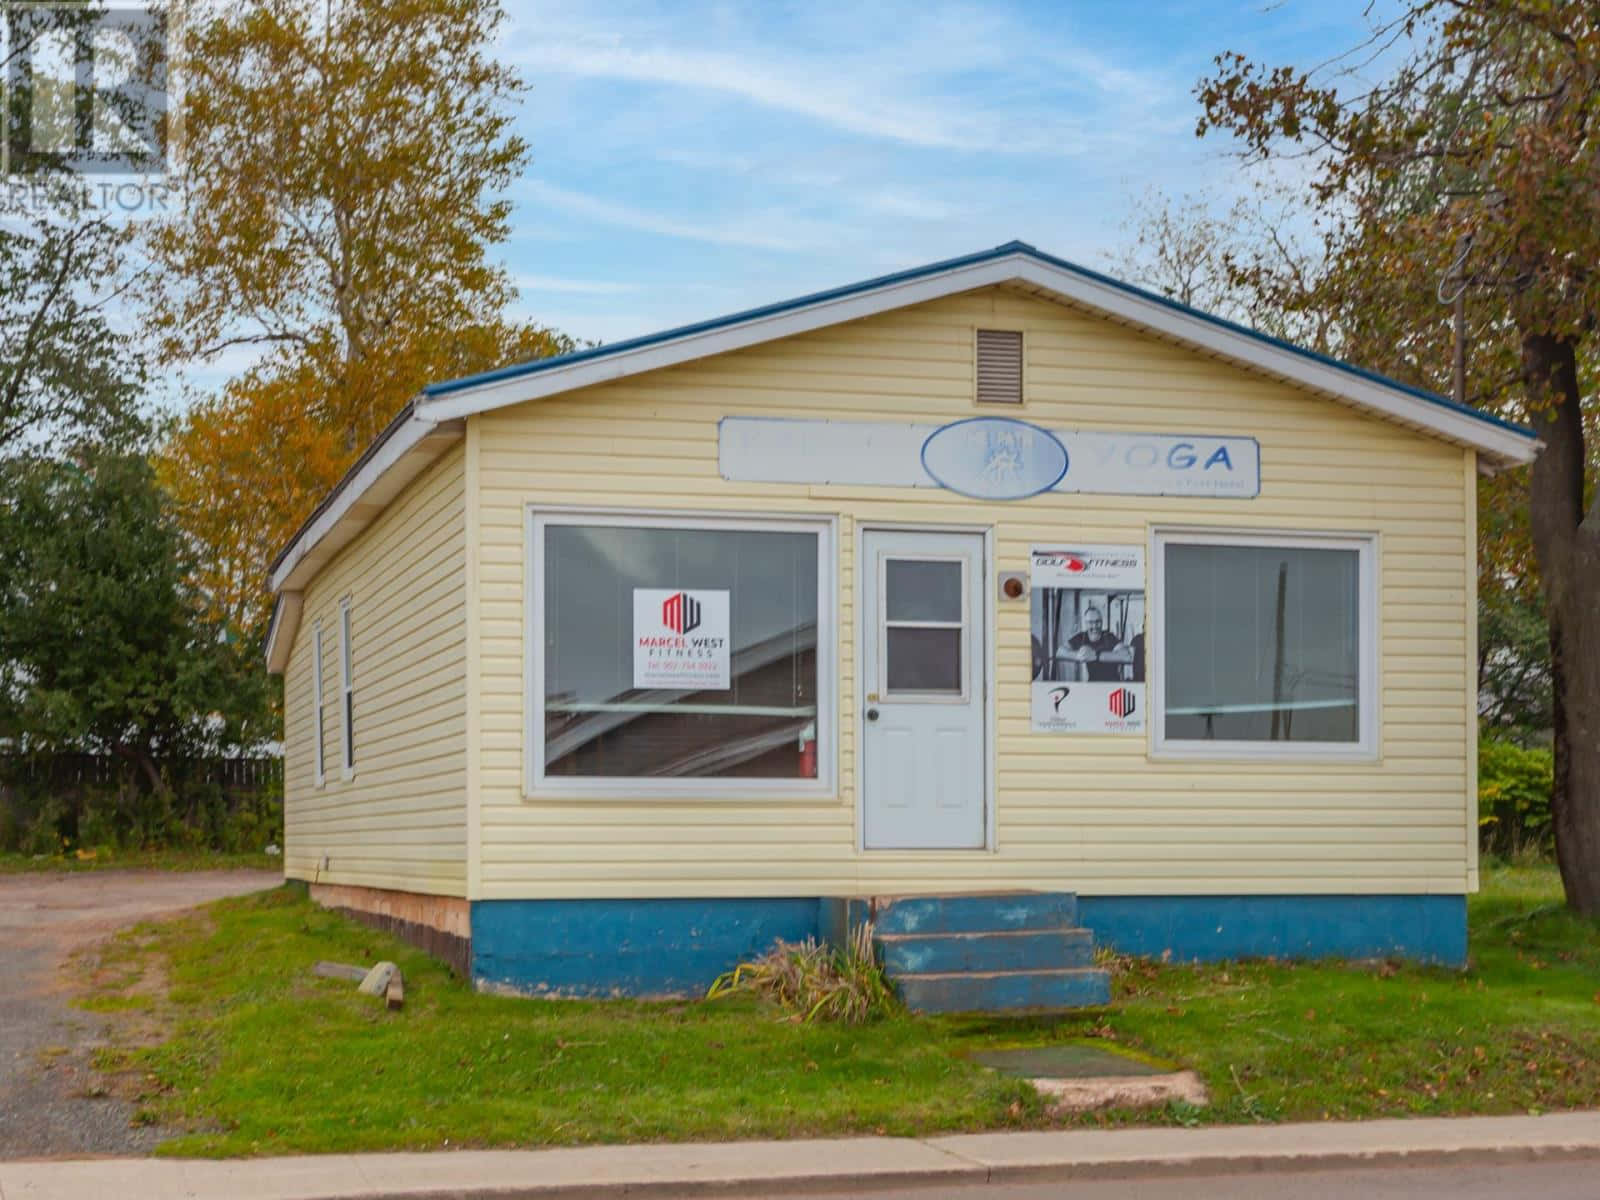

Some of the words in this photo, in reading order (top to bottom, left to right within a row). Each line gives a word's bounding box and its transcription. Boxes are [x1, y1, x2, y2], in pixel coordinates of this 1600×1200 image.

[1088, 558, 1138, 568] FITNESS
[639, 637, 688, 648] MARCEL
[691, 637, 725, 648] WEST
[648, 648, 713, 657] FITNESS
